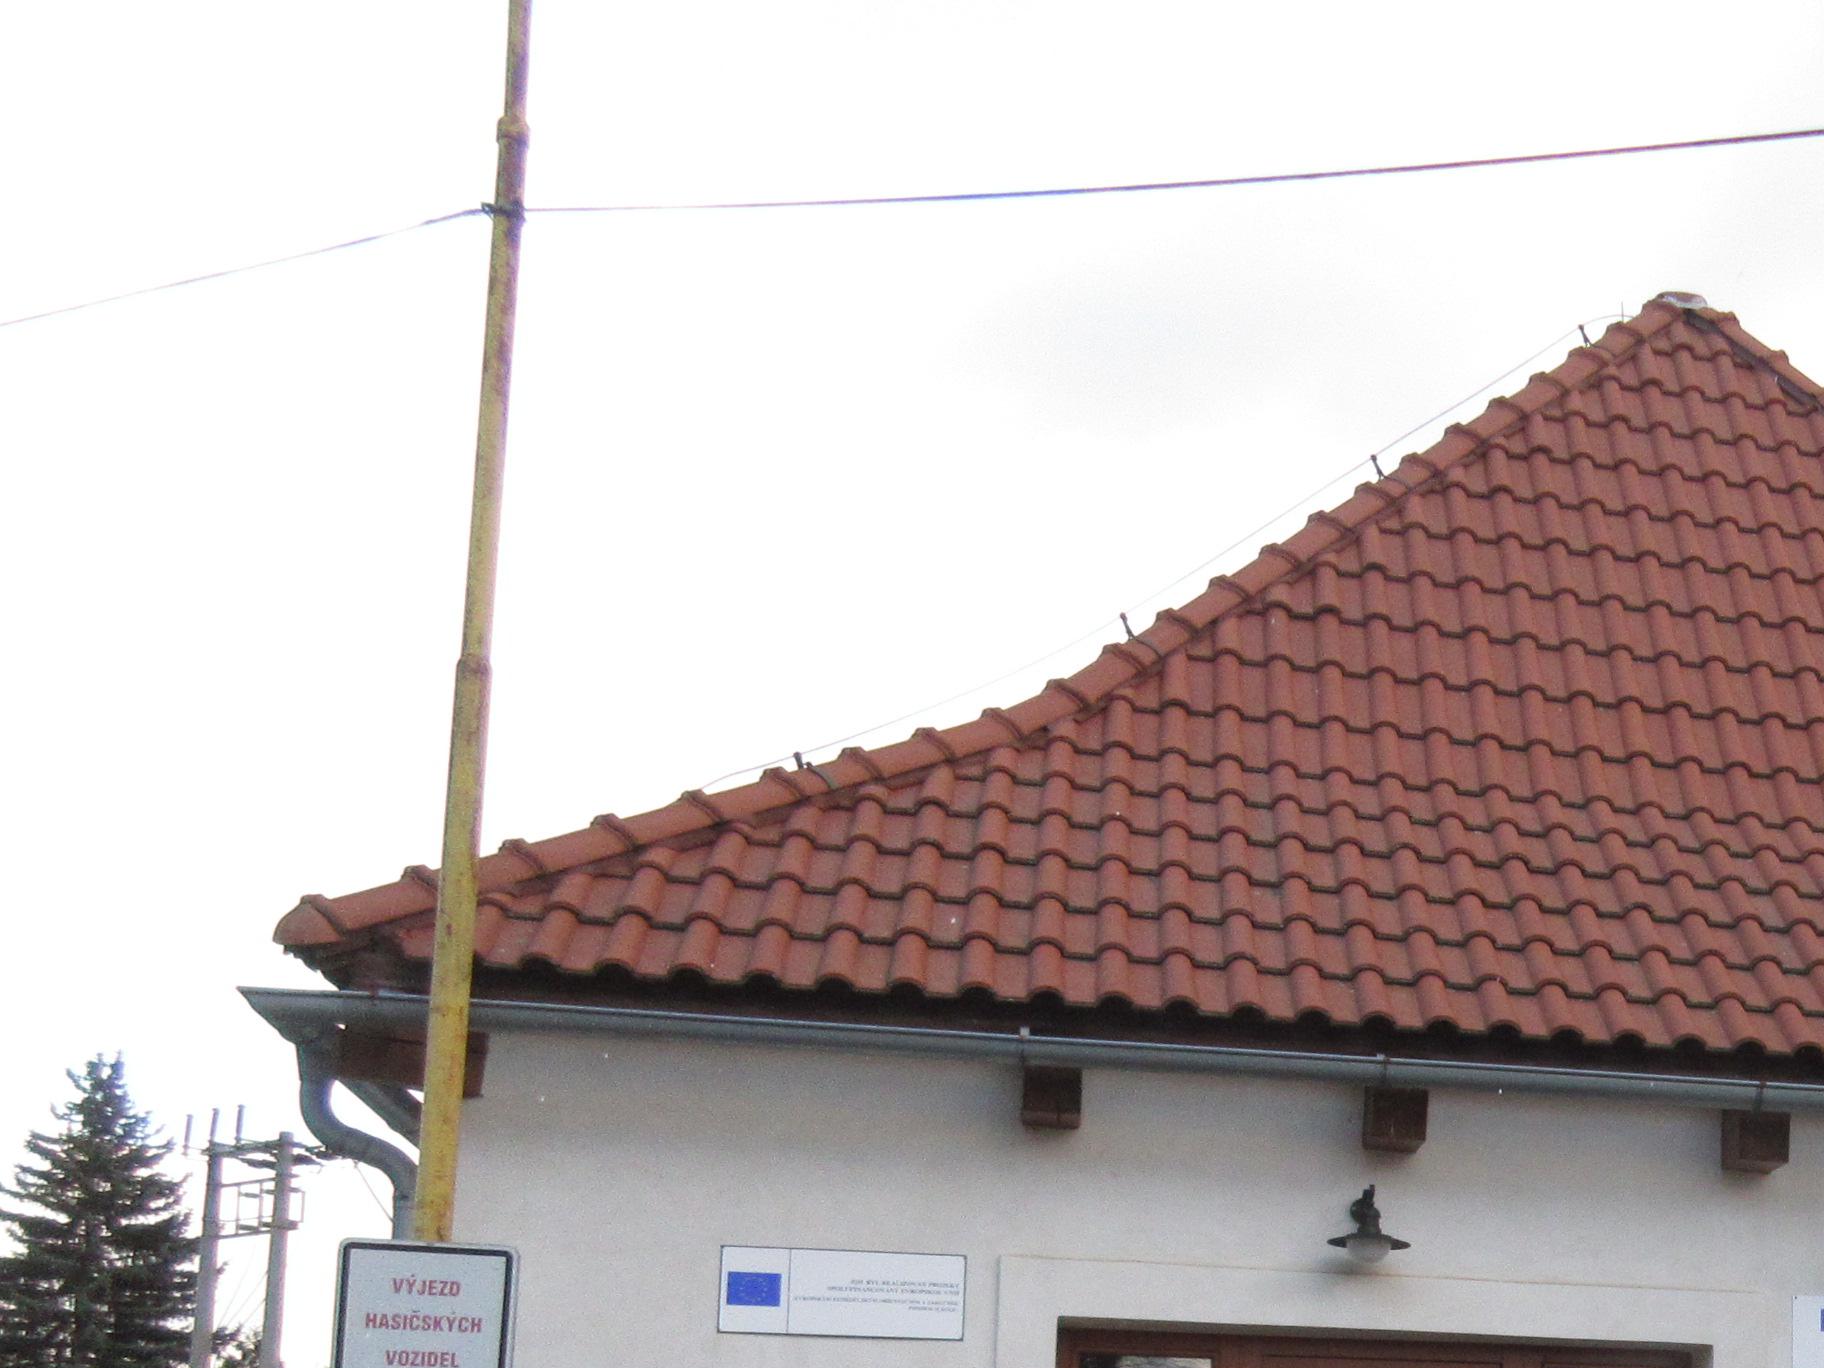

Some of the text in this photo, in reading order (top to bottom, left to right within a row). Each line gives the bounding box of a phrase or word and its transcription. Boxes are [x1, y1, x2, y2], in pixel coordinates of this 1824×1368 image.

[392, 1274, 461, 1297] VÝJEZD
[365, 1310, 483, 1333] HASIČSKÝCH
[385, 1350, 459, 1368] VOZIDEL
